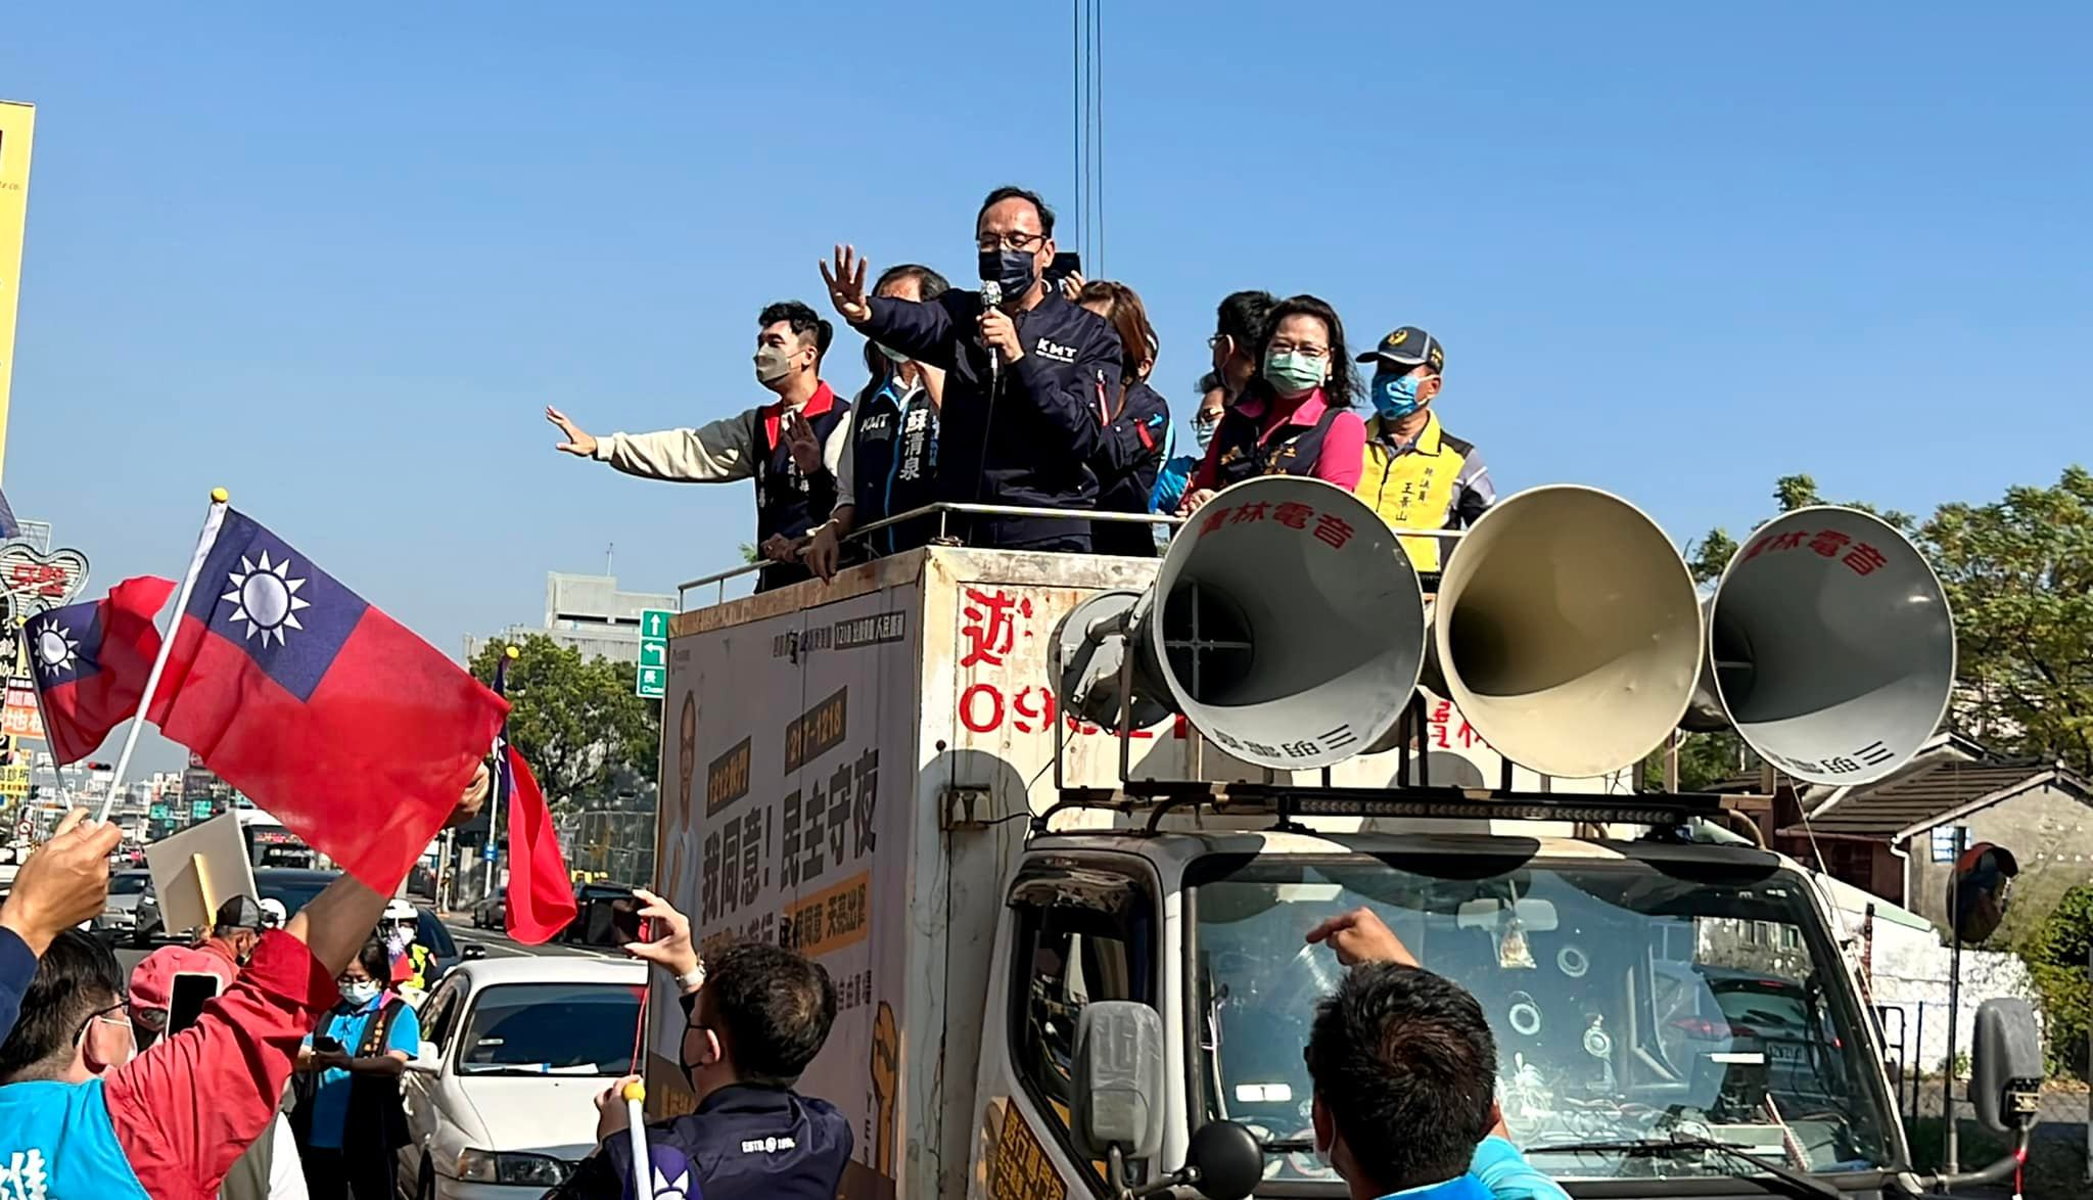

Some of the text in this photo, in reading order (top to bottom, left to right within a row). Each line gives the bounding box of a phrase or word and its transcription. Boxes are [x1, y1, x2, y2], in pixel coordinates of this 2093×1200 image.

[1037, 338, 1077, 357] KMT
[860, 413, 890, 432] KMT
[899, 408, 928, 481] 蘇清泉
[780, 747, 879, 892] 民主守夜
